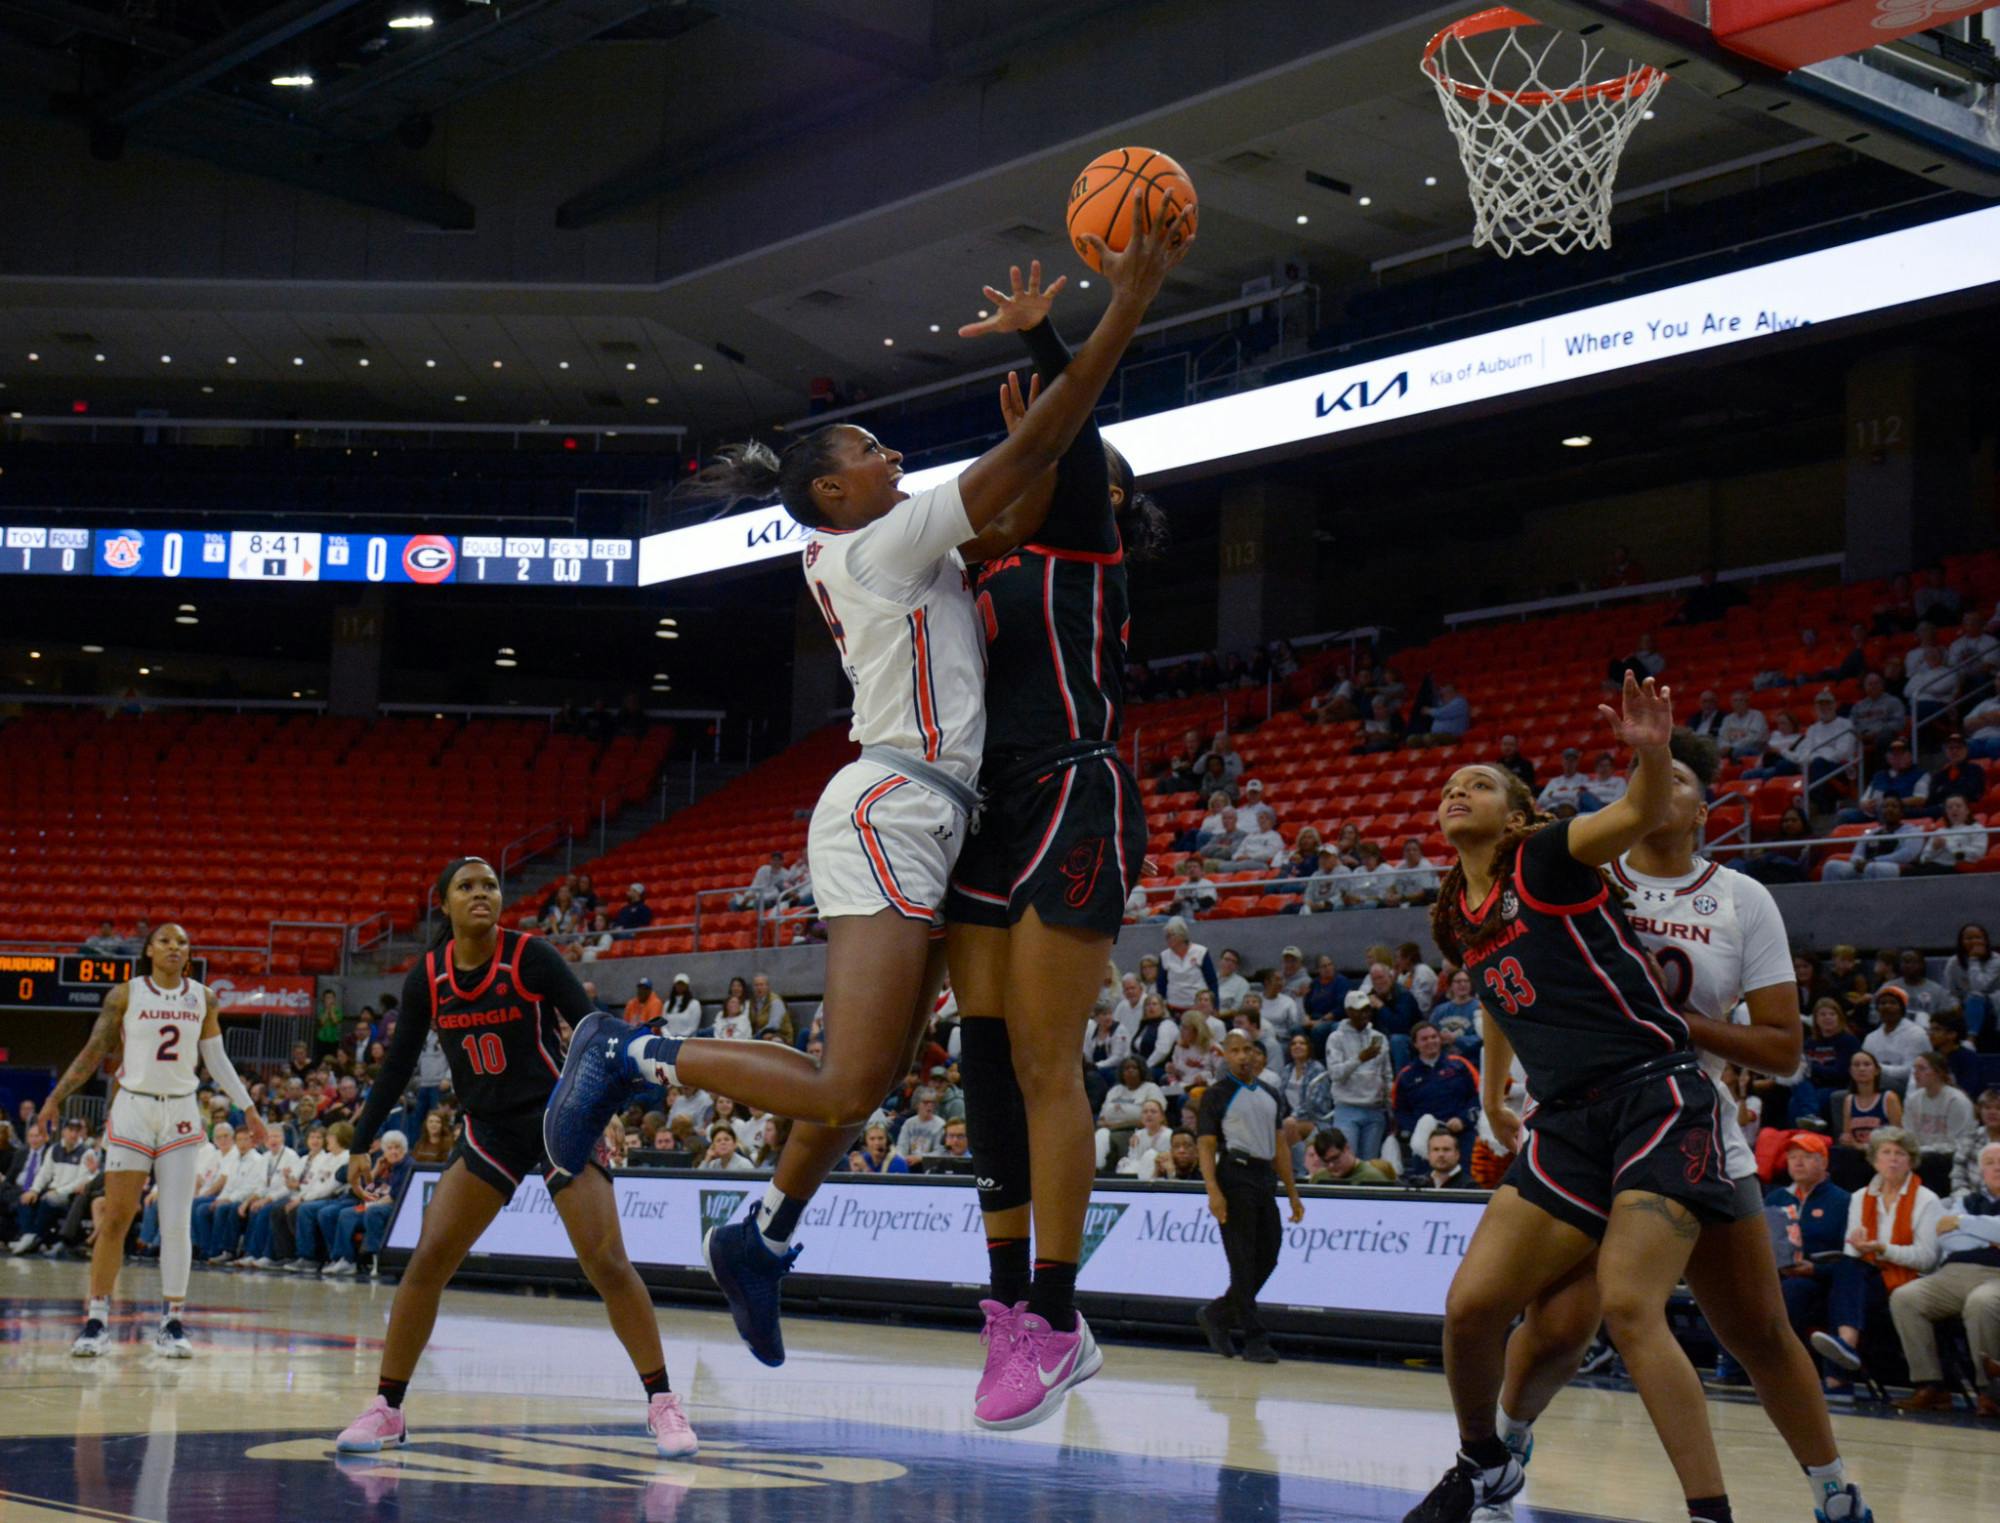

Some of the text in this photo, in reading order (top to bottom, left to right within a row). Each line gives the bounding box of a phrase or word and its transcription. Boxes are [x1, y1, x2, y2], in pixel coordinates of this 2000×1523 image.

[1565, 310, 1813, 356] Where You Are Alw
[1429, 352, 1533, 387] Kia of Auburn
[1316, 370, 1408, 418] KIA
[12, 531, 44, 545] TOV
[52, 532, 87, 546] FOULS
[250, 535, 300, 554] 8:41
[465, 541, 499, 555] FOULS
[509, 542, 542, 555] TOV
[551, 543, 570, 556] FG
[596, 543, 627, 556] REB
[22, 547, 31, 570] 1
[62, 547, 76, 571] 0
[162, 532, 183, 577] 0
[366, 537, 387, 582] 0
[271, 560, 280, 576] 1
[477, 556, 486, 580] 1
[517, 558, 530, 581] 2
[553, 558, 581, 582] 0.0
[605, 560, 614, 583] 1
[1630, 916, 1711, 945] BURN
[79, 959, 131, 981] 8:41
[19, 977, 34, 1001] 0
[1484, 956, 1537, 1015] 33
[138, 1009, 200, 1023] AUBURN
[438, 1006, 523, 1030] GEORGIA
[156, 1023, 181, 1062] 2
[462, 1032, 508, 1076] 10
[622, 1190, 669, 1219] Trust
[837, 1198, 952, 1240] Properties
[1136, 1208, 1466, 1264] Medic roperties Tru
